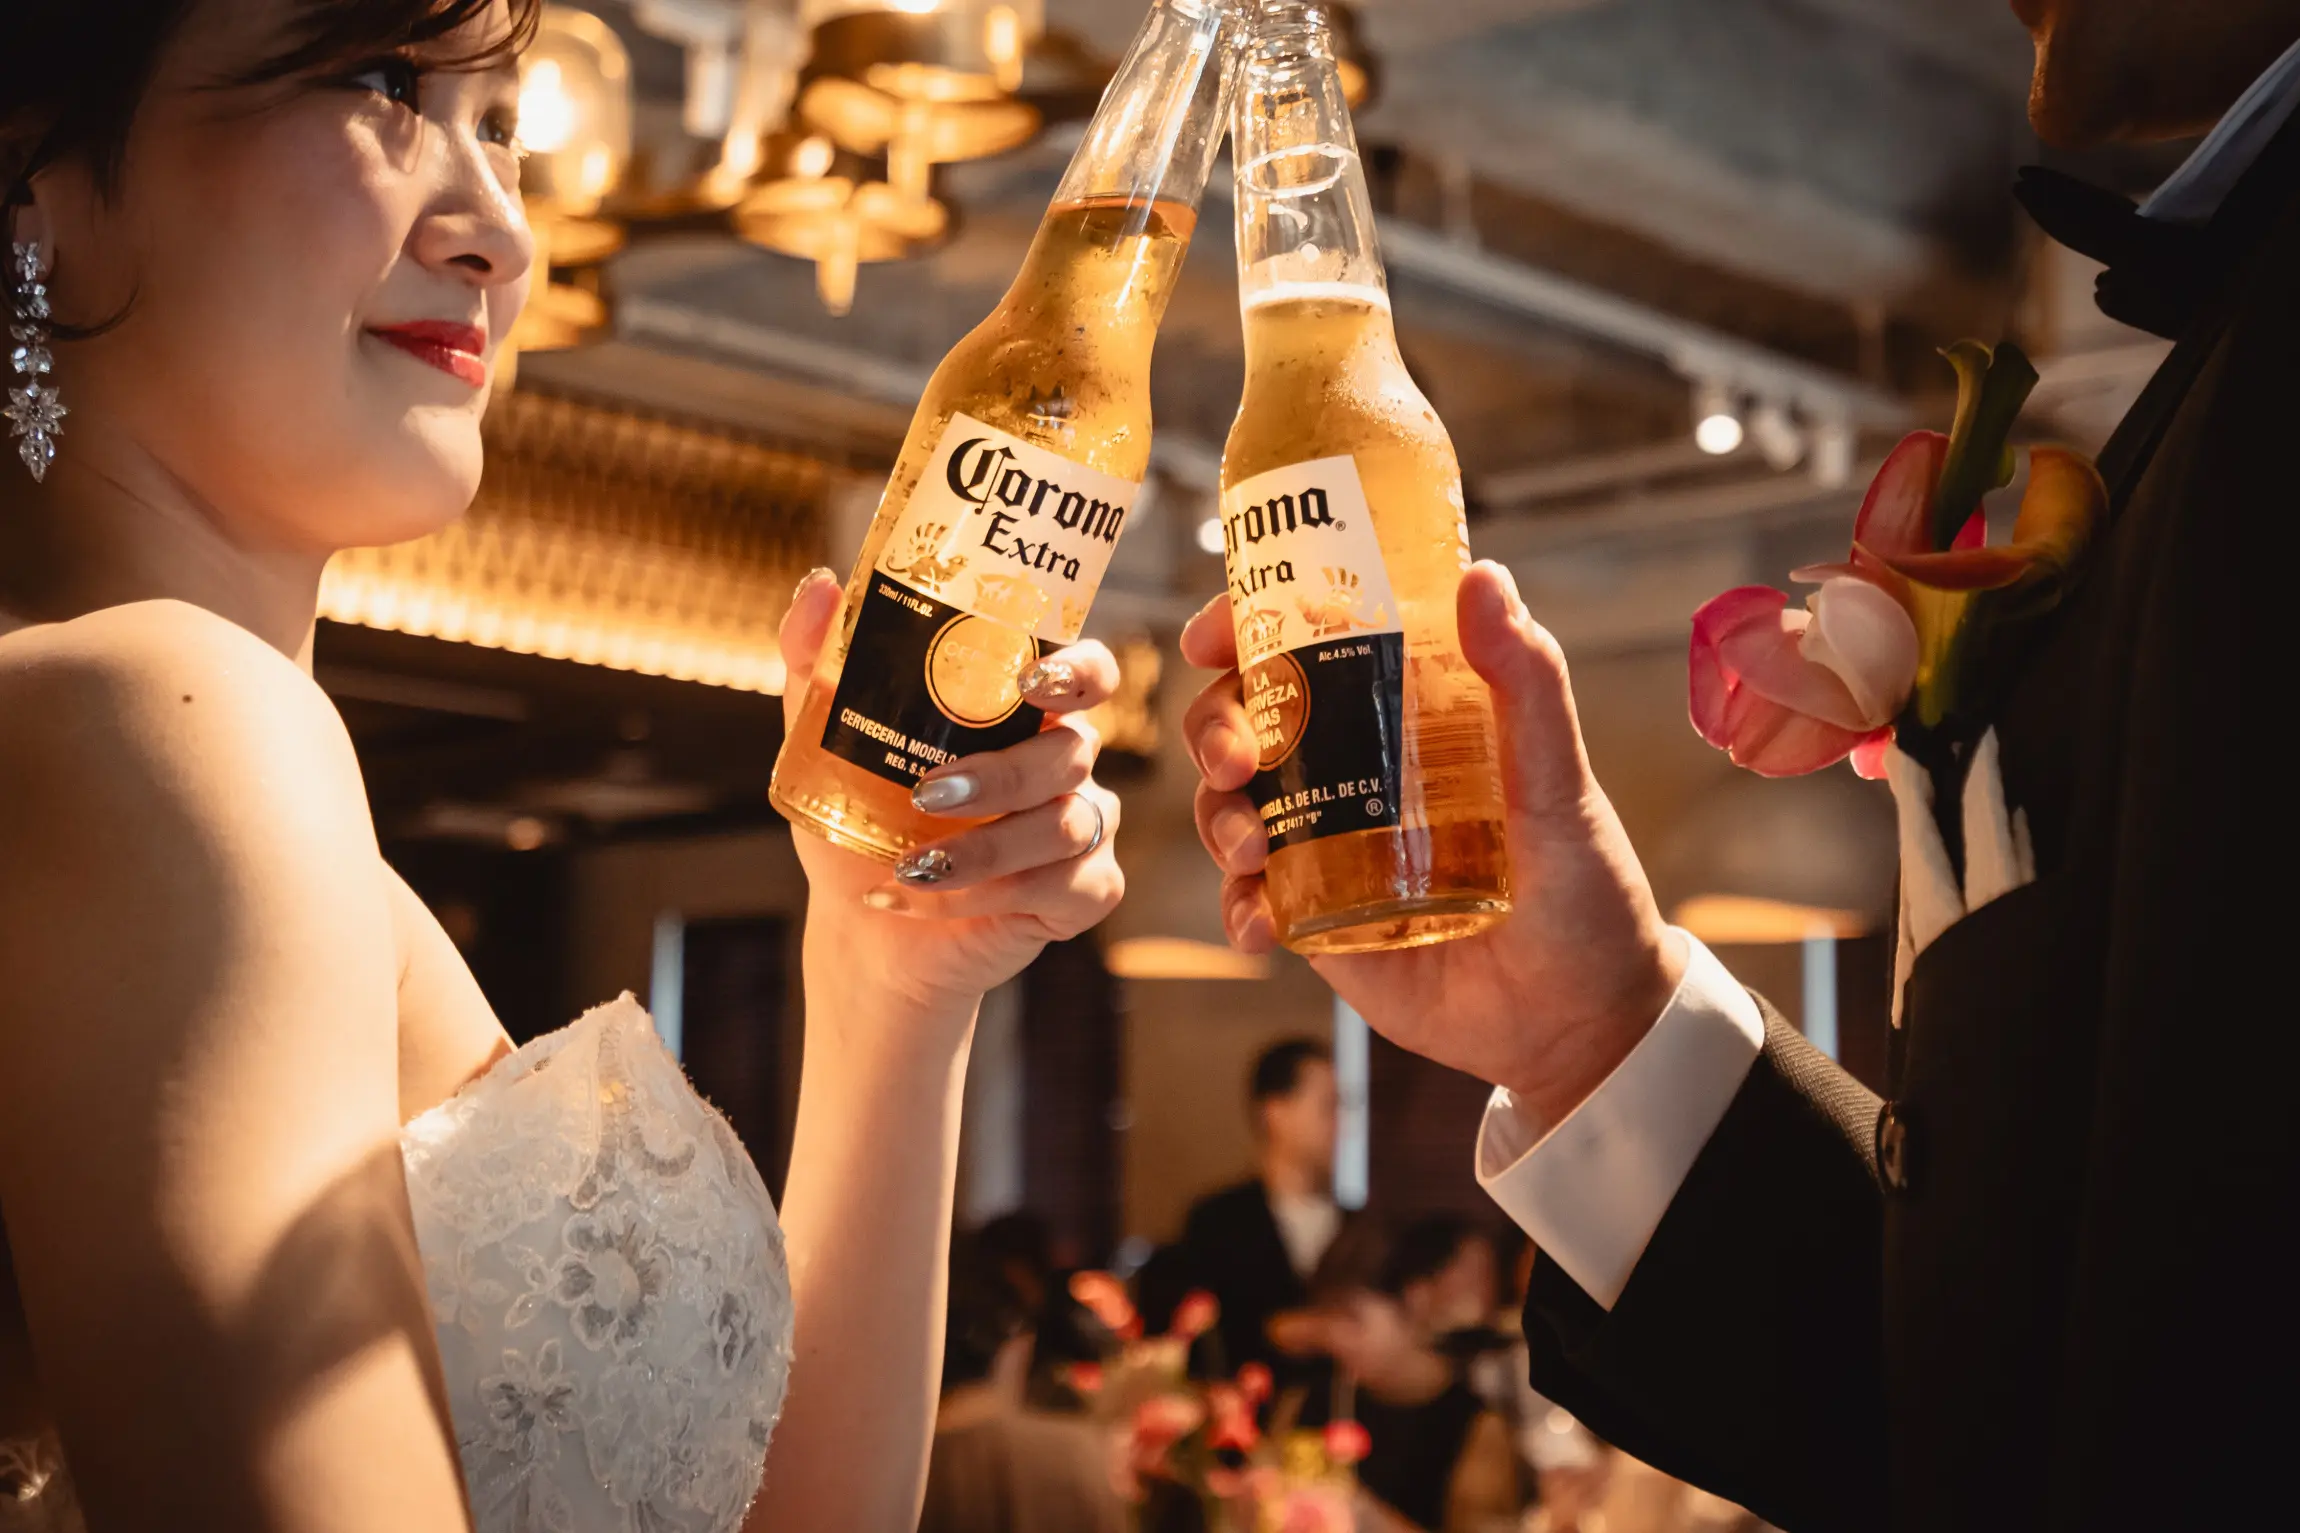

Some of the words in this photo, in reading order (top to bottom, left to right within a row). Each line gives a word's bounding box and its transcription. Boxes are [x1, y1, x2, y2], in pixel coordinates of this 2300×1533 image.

[946, 438, 1125, 546] Corona
[980, 510, 1081, 582] Extra
[1253, 671, 1270, 692] LA
[1246, 682, 1299, 717] ERVEZA
[840, 707, 907, 751] CERVECERIA
[884, 752, 907, 771] REG.
[1295, 790, 1310, 808] DE
[1312, 787, 1335, 803] R.L.
[1338, 781, 1356, 798] DE
[1359, 778, 1383, 795] C.V.
